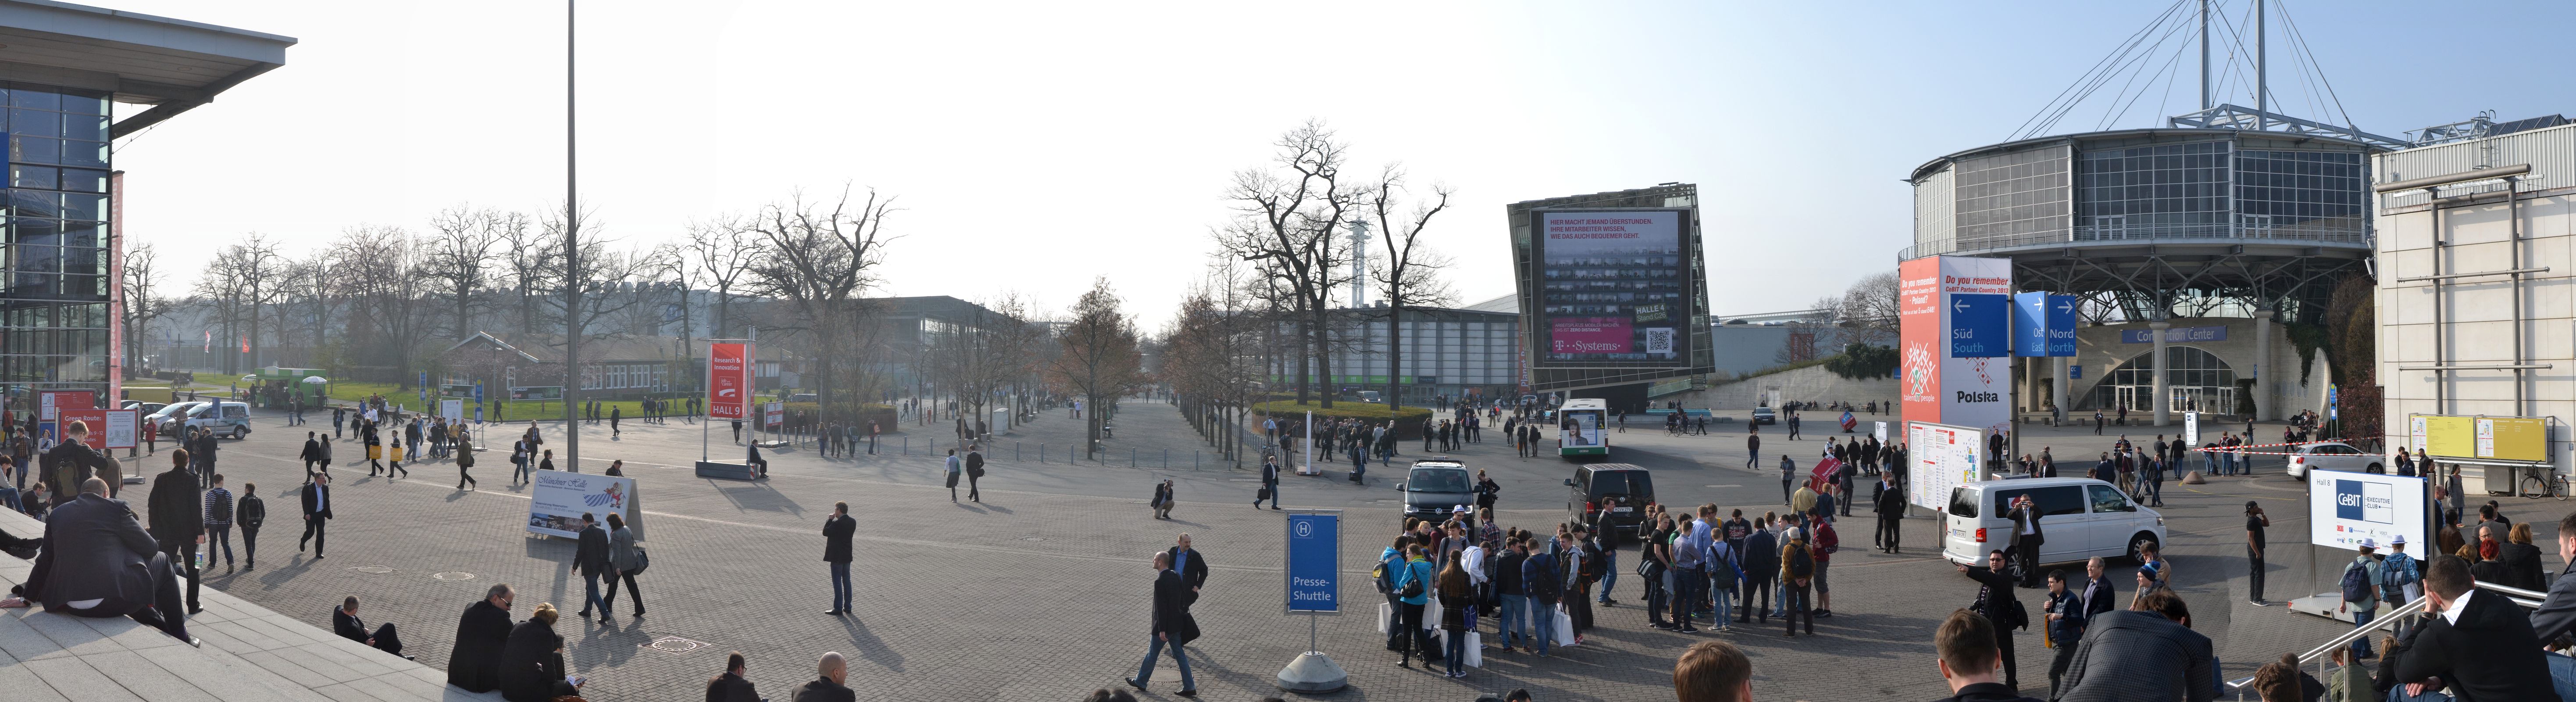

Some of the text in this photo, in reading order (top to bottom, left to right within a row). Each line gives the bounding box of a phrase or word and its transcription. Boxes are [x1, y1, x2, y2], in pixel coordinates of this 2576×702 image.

[1902, 280, 1907, 288] Do
[1916, 276, 1937, 286] remember
[1912, 295, 1928, 304] Poland?
[1636, 305, 1659, 314] HALLE
[1637, 313, 1653, 322] Stand
[1954, 329, 1973, 339] Süd
[2034, 328, 2044, 337] Ost
[2050, 329, 2074, 339] Nord
[2137, 329, 2214, 342] Conntion Center
[1954, 342, 1984, 353] South
[2032, 342, 2044, 352] East
[2048, 342, 2074, 352] North
[1921, 394, 1934, 402] people
[1957, 391, 1999, 403] Polska
[713, 406, 733, 415] HALL
[1822, 465, 1835, 476] Experience
[538, 476, 587, 488] Münchner Halle
[2338, 493, 2361, 507] CeBIT
[1300, 525, 1307, 534] H
[1294, 577, 1330, 586] Presse-
[1294, 591, 1331, 601] Shuttle
